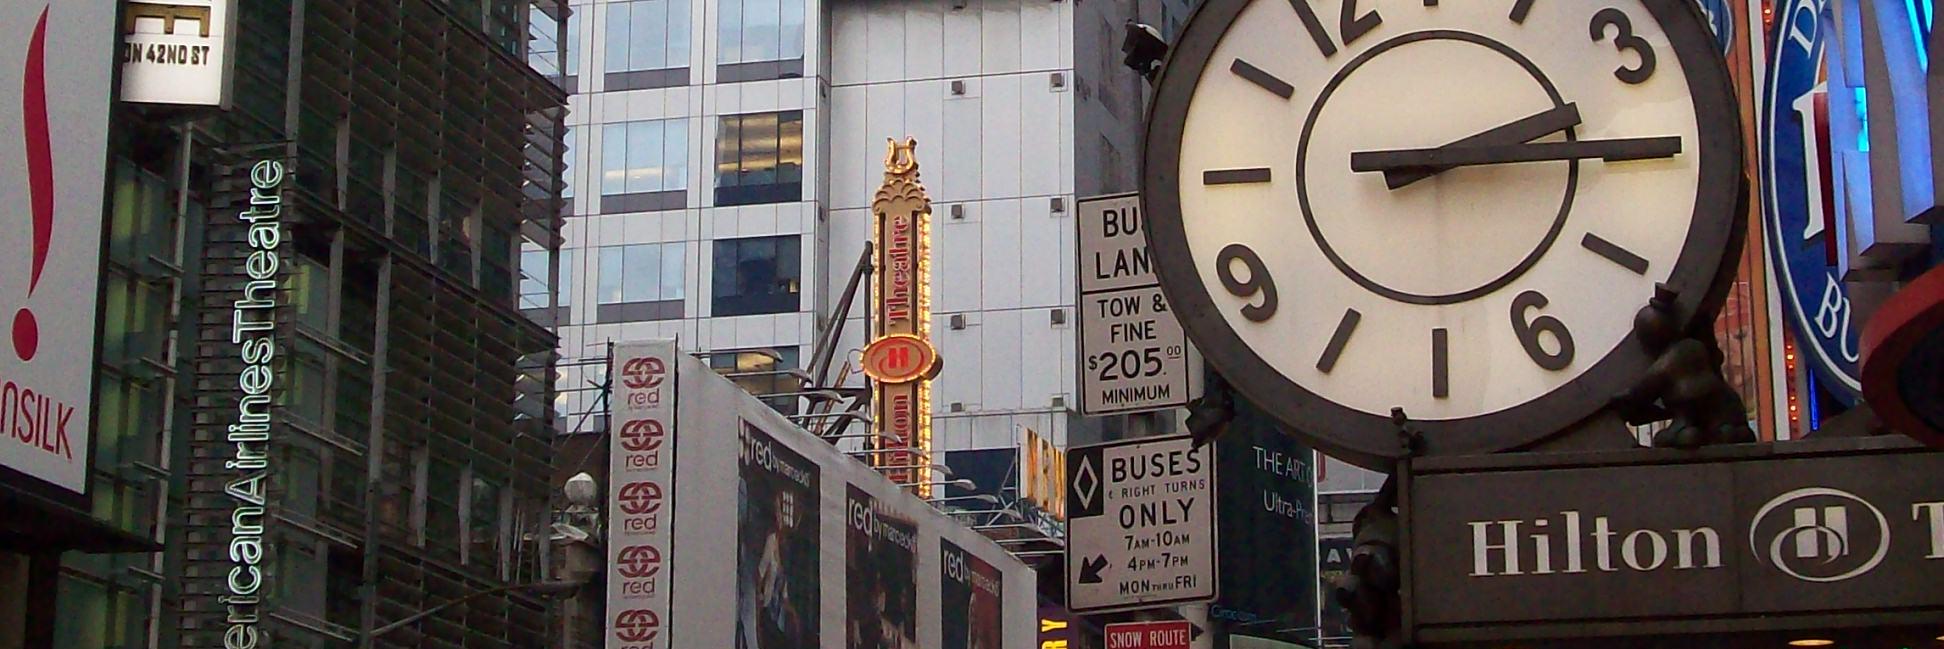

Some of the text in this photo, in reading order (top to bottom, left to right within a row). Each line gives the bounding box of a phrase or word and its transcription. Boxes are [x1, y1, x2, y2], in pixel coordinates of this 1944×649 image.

[146, 43, 187, 65] 42ND
[191, 45, 210, 65] ST
[1588, 7, 1657, 85] 3
[1103, 206, 1140, 238] BU
[887, 214, 909, 327] Theatre
[1095, 246, 1151, 280] LAN
[1216, 243, 1279, 323] 9
[1097, 293, 1167, 318] TOW &
[1110, 320, 1157, 343] FINE
[1509, 289, 1576, 371] 6
[627, 389, 660, 405] red
[1102, 384, 1170, 404] MINIMUM
[625, 451, 659, 467] red
[751, 437, 772, 473] red
[1112, 450, 1201, 483] BUSES
[1252, 445, 1284, 476] THE
[1285, 456, 1306, 482] ART
[1122, 485, 1155, 498] RIGHT
[1165, 479, 1205, 493] TURNS
[624, 514, 657, 531] red
[849, 497, 873, 538] red
[1119, 497, 1195, 530] ONLY
[1468, 511, 1724, 577] Hilton
[944, 549, 964, 584] red
[622, 578, 655, 595] red
[1119, 580, 1150, 595] MON
[1175, 574, 1197, 589] FRI
[1110, 629, 1186, 649] SNOW ROUTE
